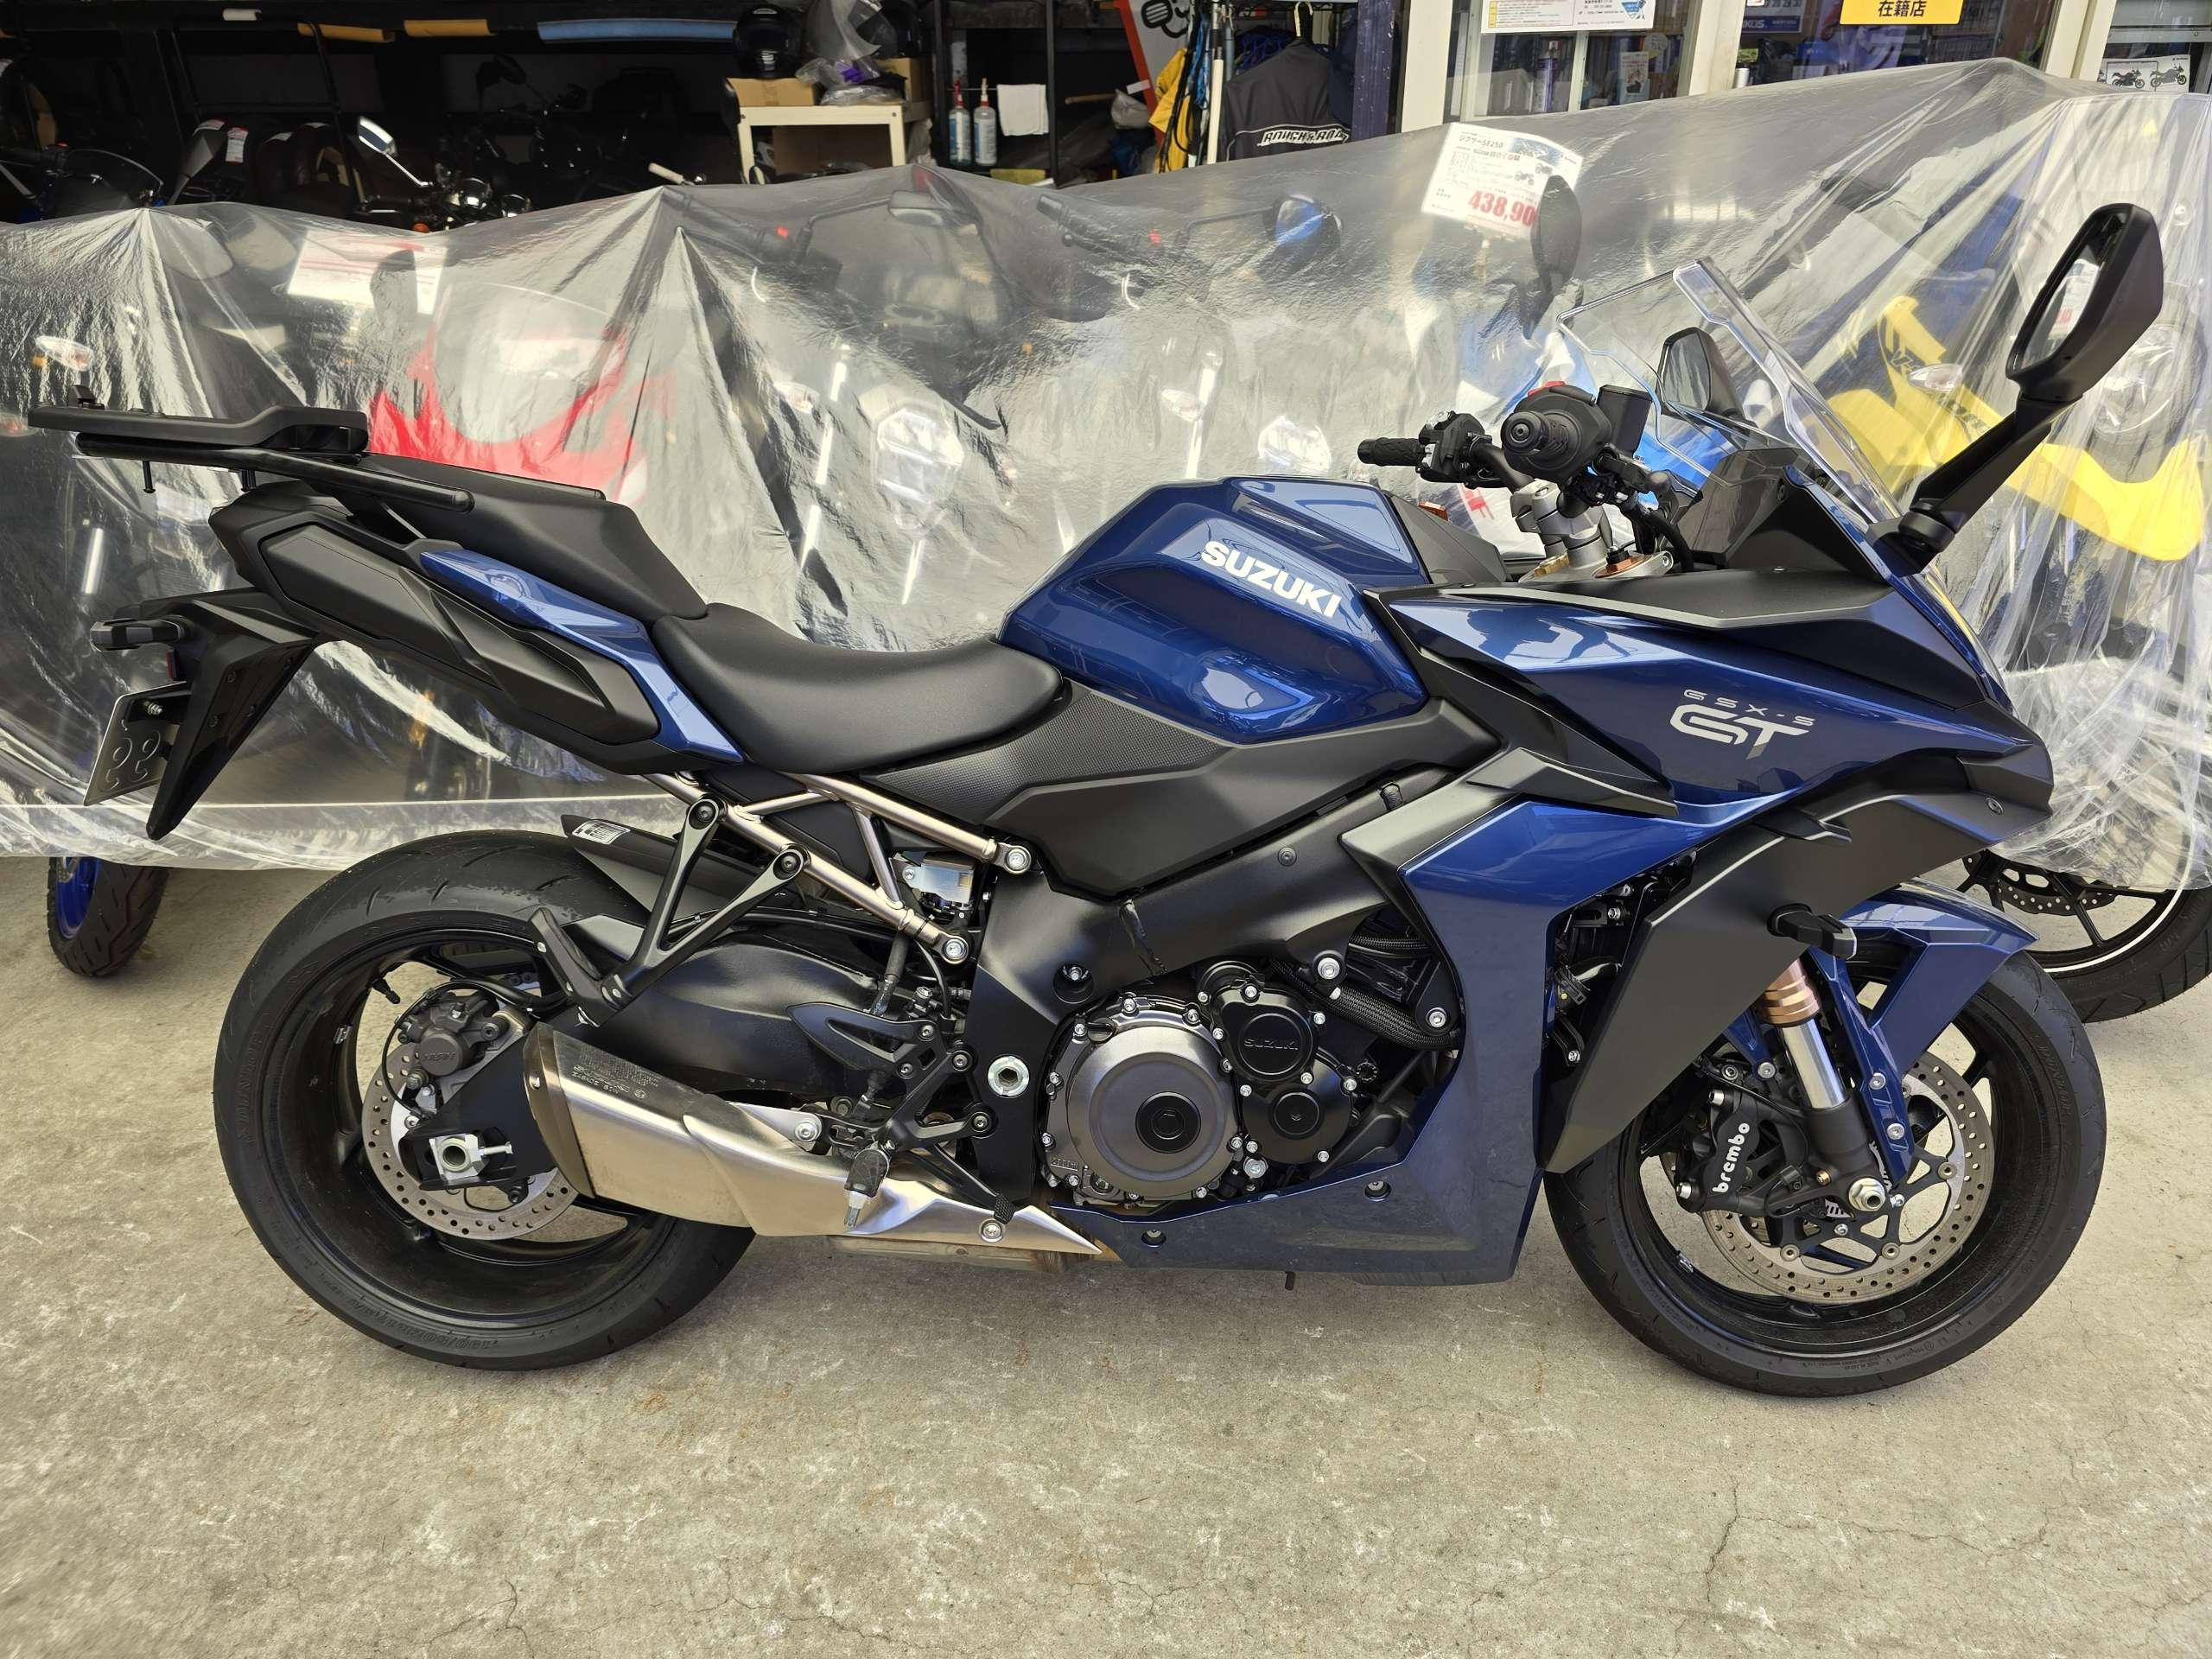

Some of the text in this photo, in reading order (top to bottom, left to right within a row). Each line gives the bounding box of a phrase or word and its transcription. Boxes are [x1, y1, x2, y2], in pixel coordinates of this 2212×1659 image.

[1878, 0, 1927, 17] 在籍店
[1469, 190, 1537, 226] 438,90
[1201, 540, 1342, 618] SUZUKI
[1712, 1122, 1751, 1193] brembo
